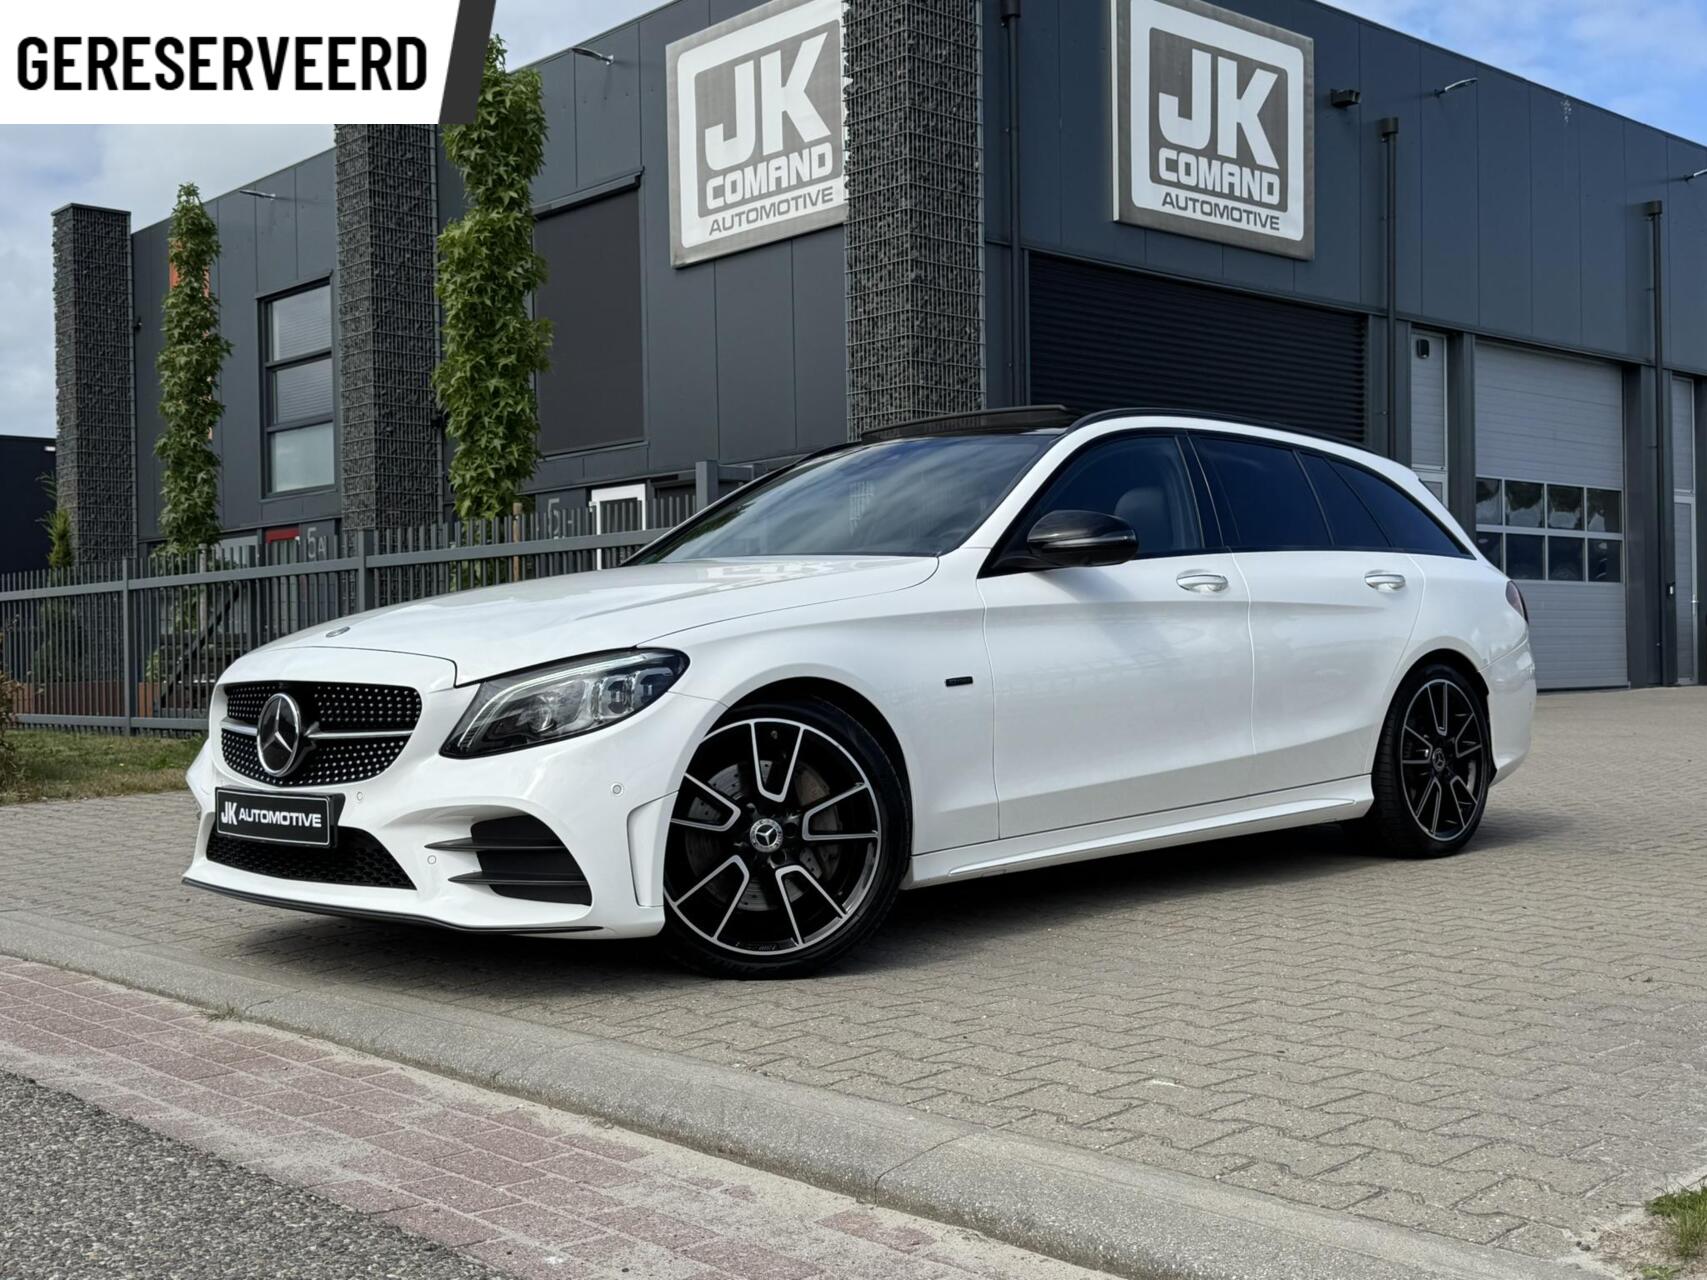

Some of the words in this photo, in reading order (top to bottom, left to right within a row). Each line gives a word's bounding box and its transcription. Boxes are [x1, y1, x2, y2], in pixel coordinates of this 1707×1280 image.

[705, 32, 832, 171] JK
[1158, 48, 1280, 170] JK
[706, 142, 833, 210] COMAND
[1158, 147, 1280, 206] COMAND
[709, 186, 833, 236] AUTOMOTIVE
[1162, 192, 1280, 231] AUTOMOTIVE
[221, 801, 238, 825] JK
[238, 808, 322, 827] AUTOMOTIVE
